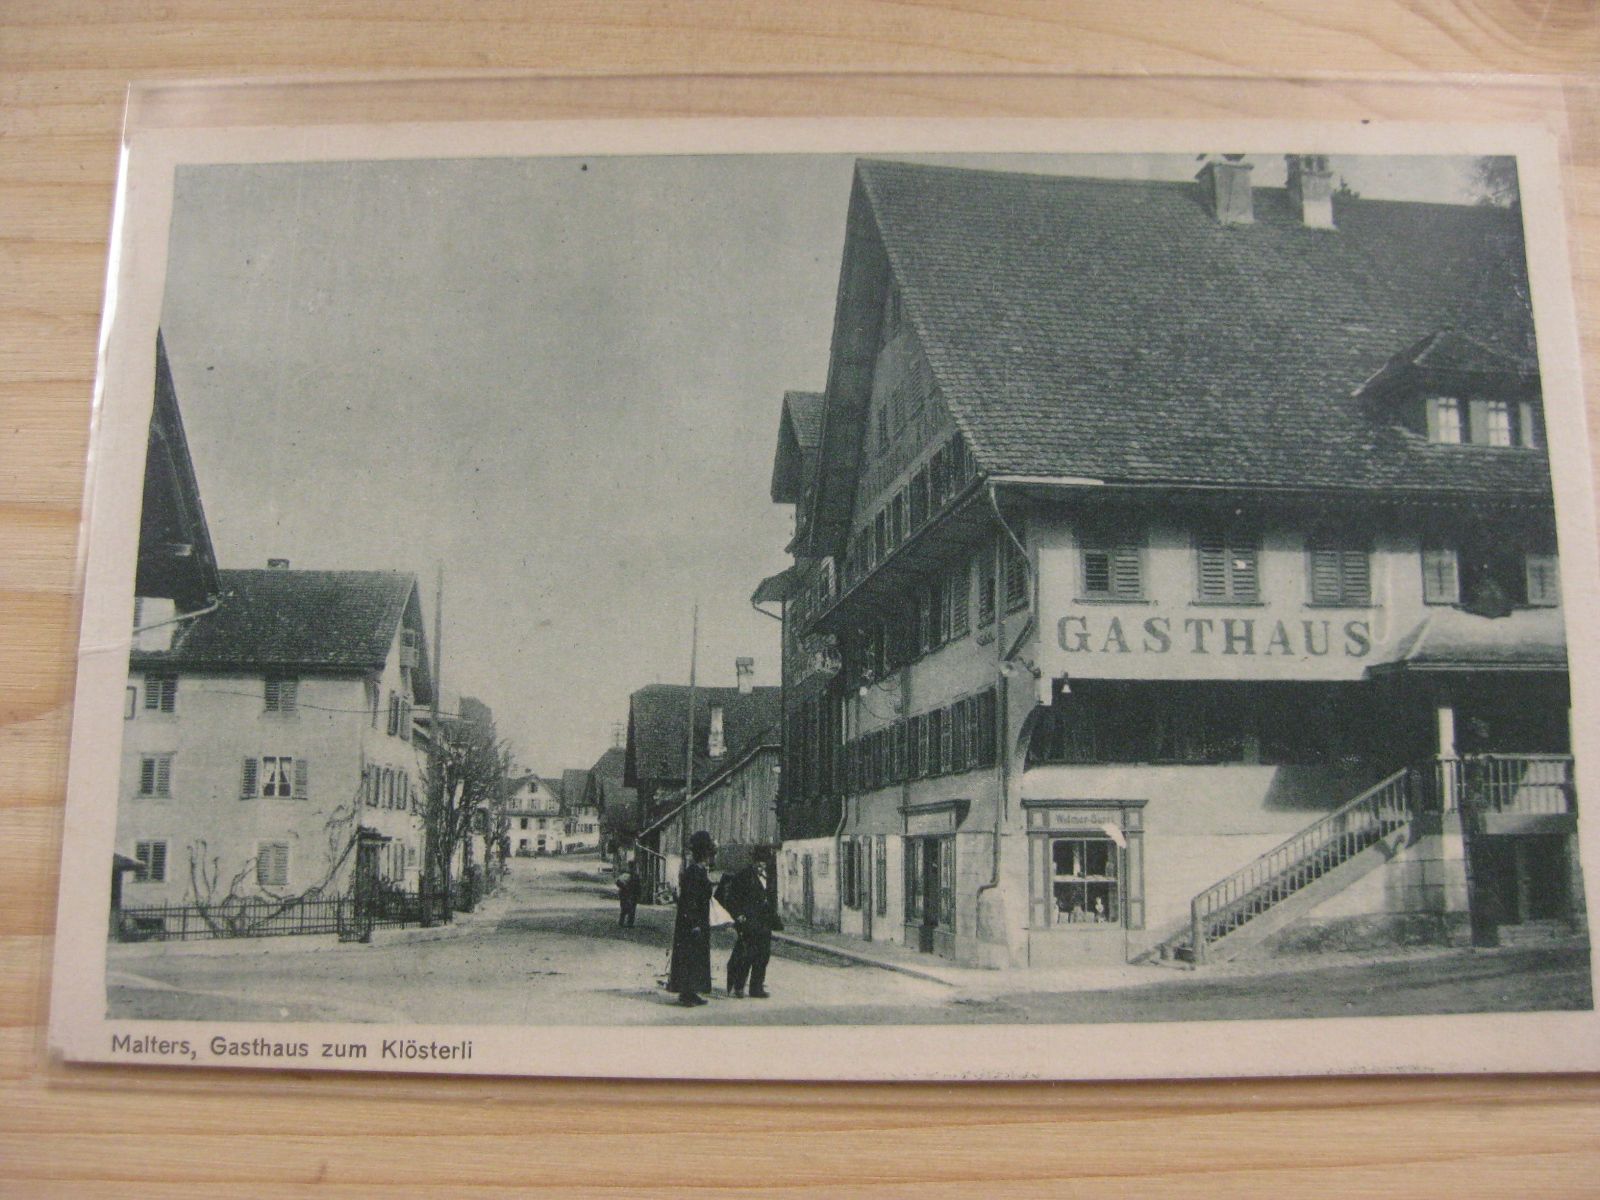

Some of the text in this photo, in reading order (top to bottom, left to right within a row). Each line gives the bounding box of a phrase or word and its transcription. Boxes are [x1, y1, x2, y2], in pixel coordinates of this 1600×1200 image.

[1057, 615, 1372, 658] GASTHAUS
[111, 1034, 473, 1060] Malters, Gasthaus zum Klösterli
